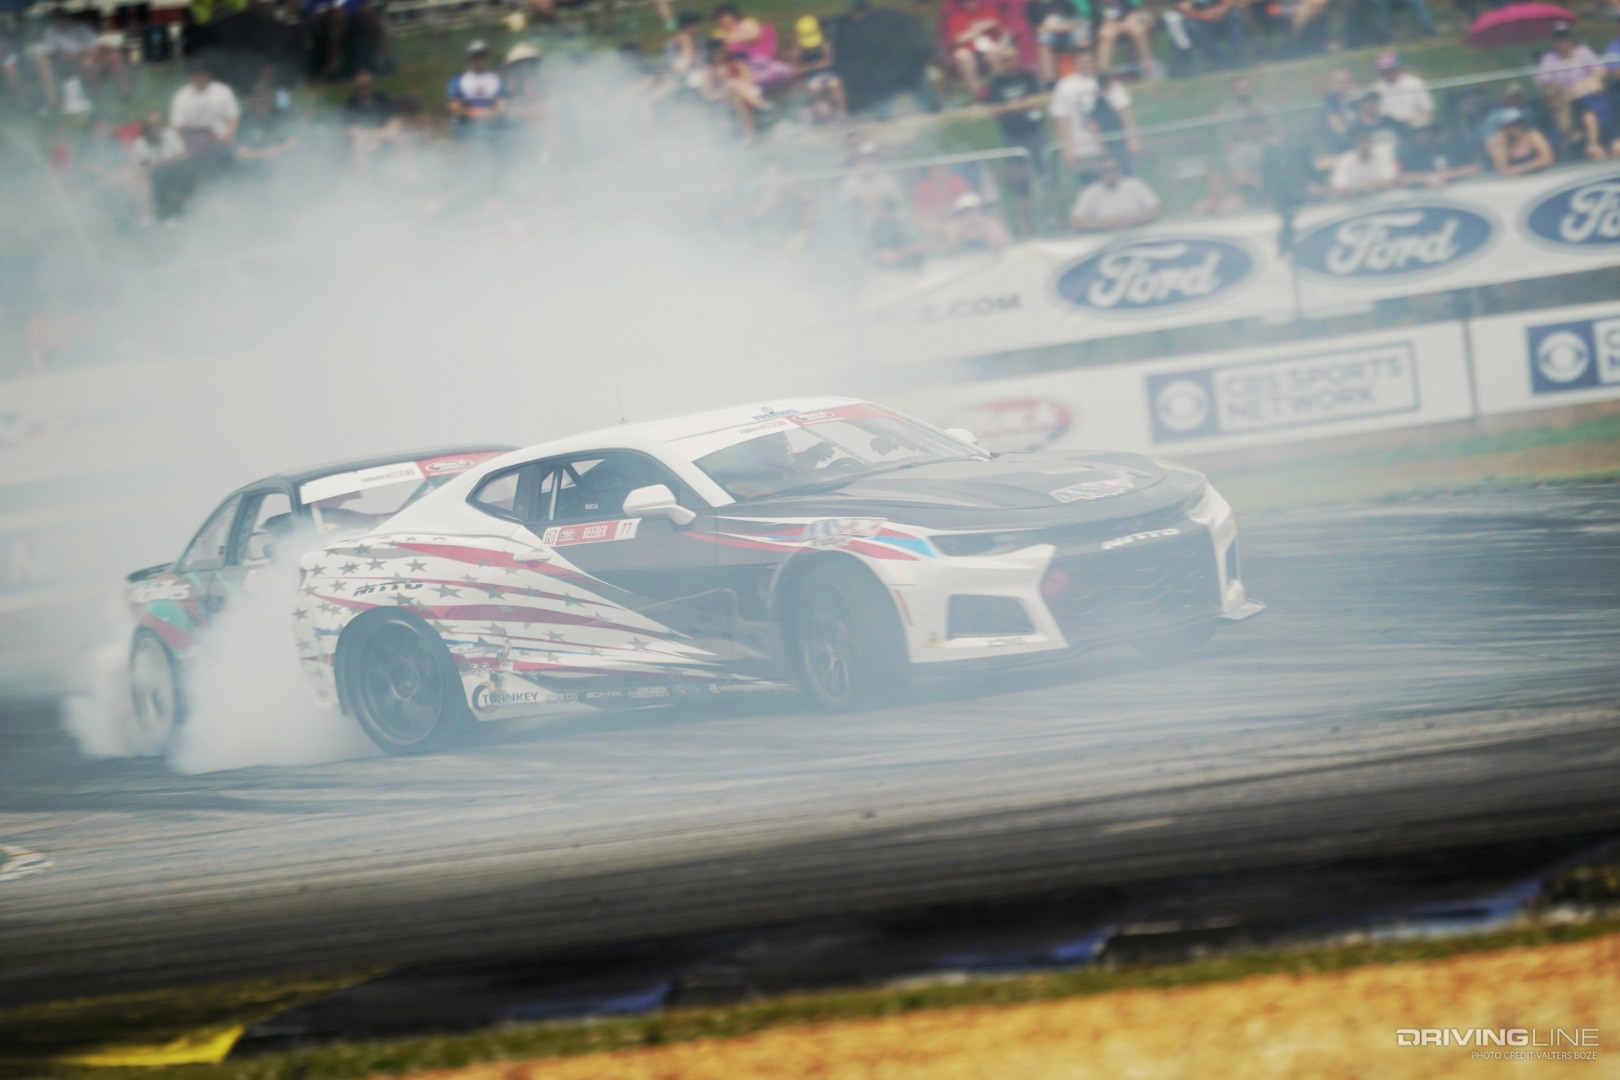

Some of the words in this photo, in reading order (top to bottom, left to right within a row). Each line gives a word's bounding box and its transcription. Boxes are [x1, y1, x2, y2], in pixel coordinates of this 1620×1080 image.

[1327, 212, 1459, 275] Ford
[1086, 242, 1223, 307] Ford
[1225, 373, 1279, 396] CBS
[1288, 356, 1403, 386] SPORTS
[1227, 386, 1375, 419] NETWORK
[582, 525, 609, 539] REEDER
[620, 522, 634, 536] 77
[482, 691, 539, 705] TURNKEY
